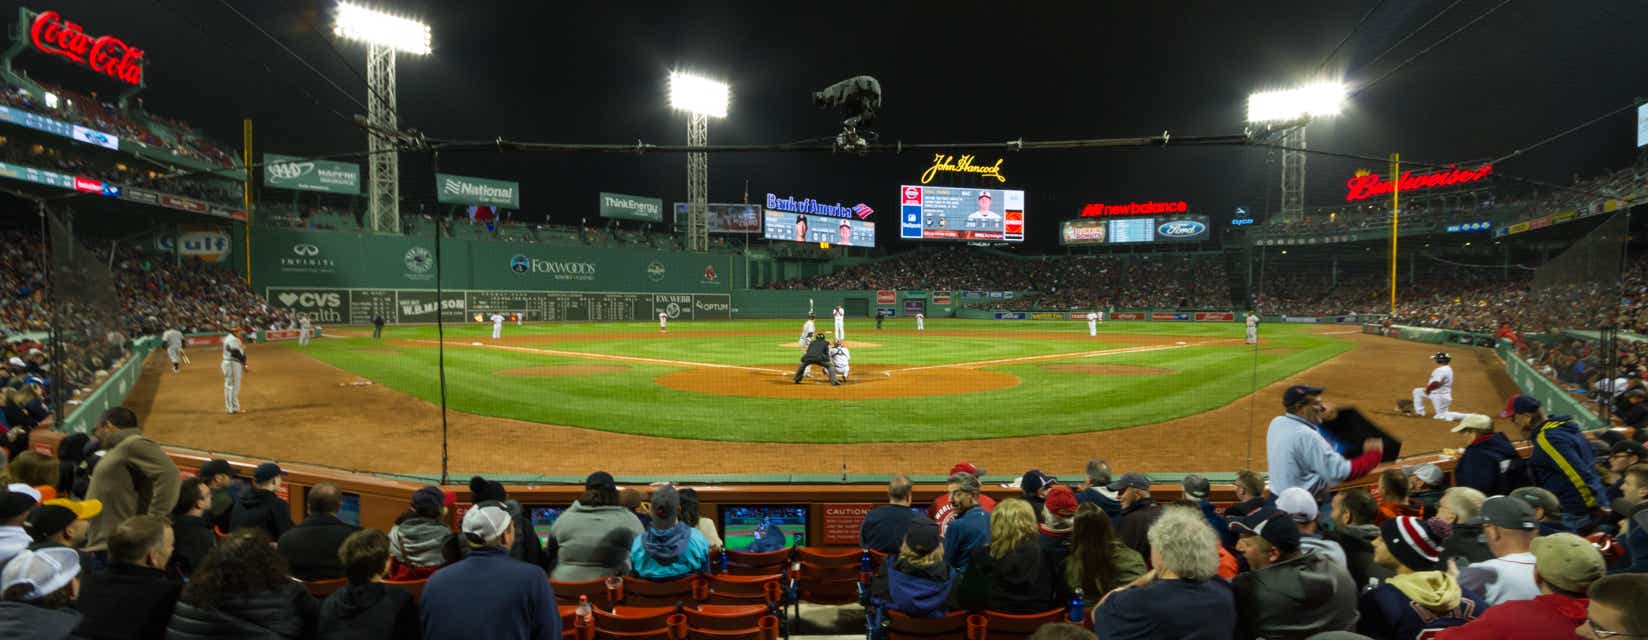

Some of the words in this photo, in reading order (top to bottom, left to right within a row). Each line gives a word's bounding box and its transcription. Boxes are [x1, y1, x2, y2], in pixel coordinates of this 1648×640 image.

[32, 11, 144, 85] Coca-Cola
[921, 154, 956, 184] John
[957, 154, 1006, 183] Hancock
[461, 182, 513, 198] National
[1346, 164, 1492, 201] Budweiser
[605, 196, 657, 214] ThinkEnergy
[767, 193, 797, 212] Bank
[797, 198, 809, 213] of
[811, 199, 852, 218] America
[1167, 223, 1196, 235] Ford
[300, 292, 341, 307] CVS
[703, 303, 728, 311] OPTUM
